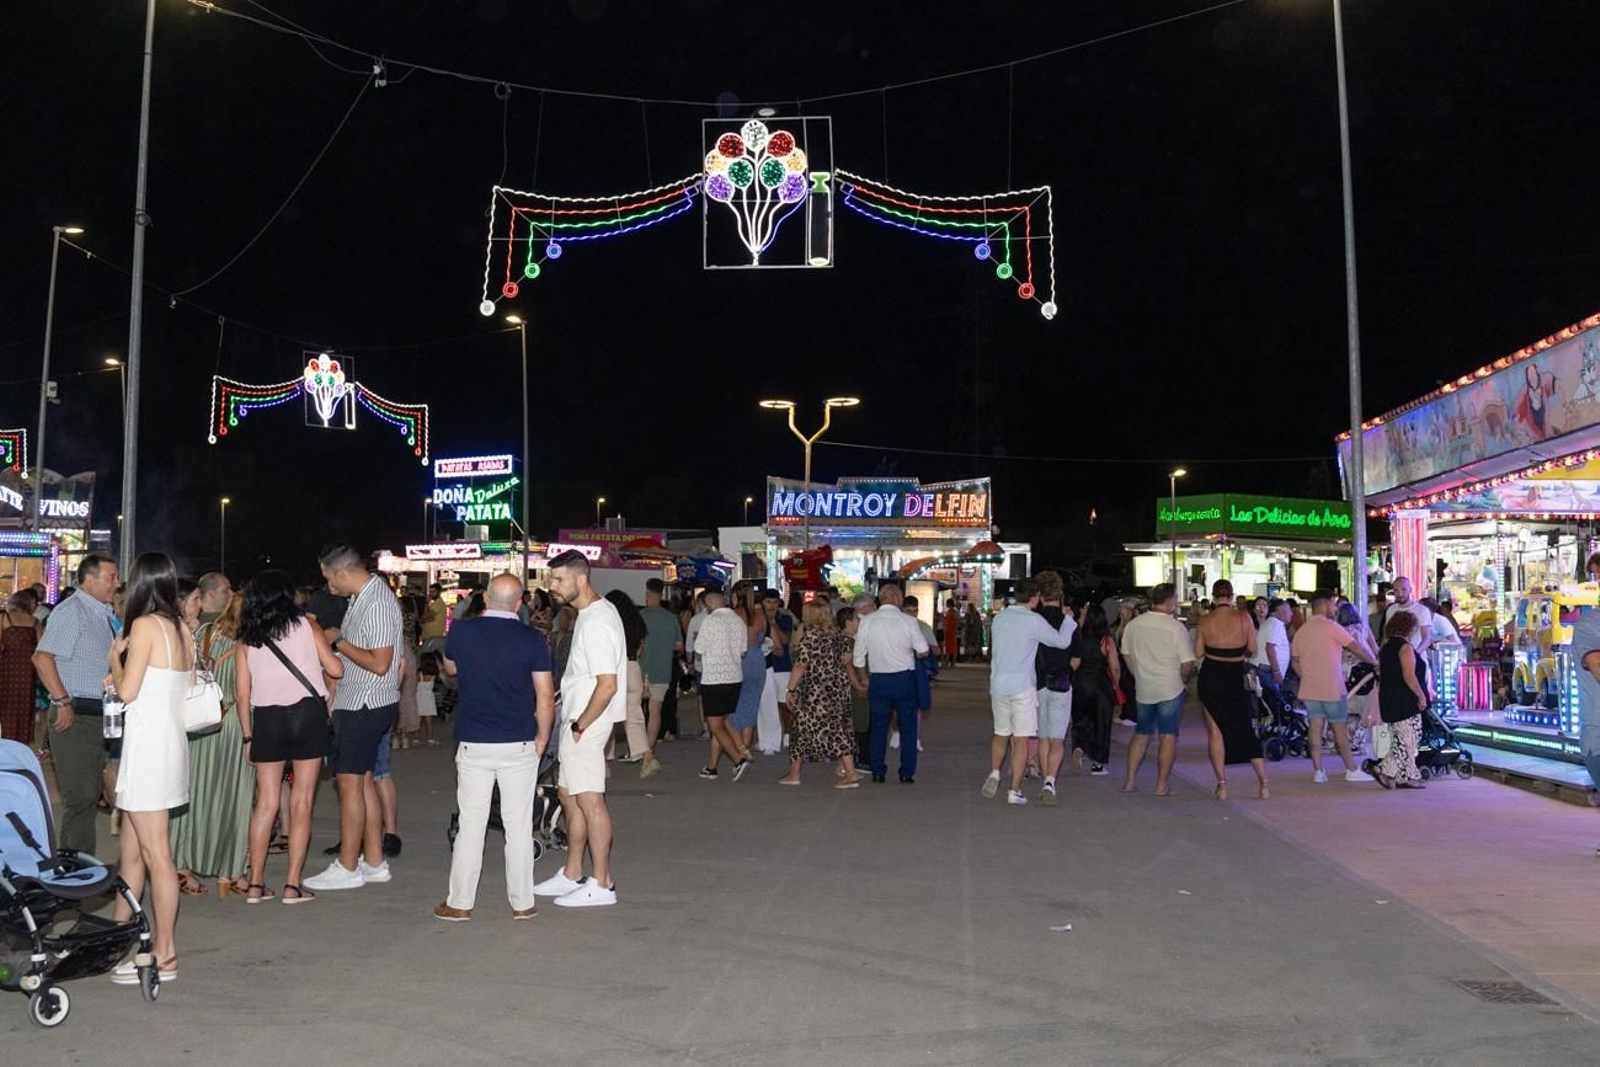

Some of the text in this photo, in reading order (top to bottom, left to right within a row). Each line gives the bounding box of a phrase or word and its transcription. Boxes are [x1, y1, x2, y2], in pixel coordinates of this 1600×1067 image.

[441, 461, 473, 473] PATATAS
[433, 483, 475, 504] DOÑA
[456, 503, 512, 521] PATATA
[771, 492, 987, 518] MONTROY DELFIN
[1230, 504, 1253, 522] Las
[1254, 506, 1306, 525] Delicias
[1307, 509, 1321, 527] de
